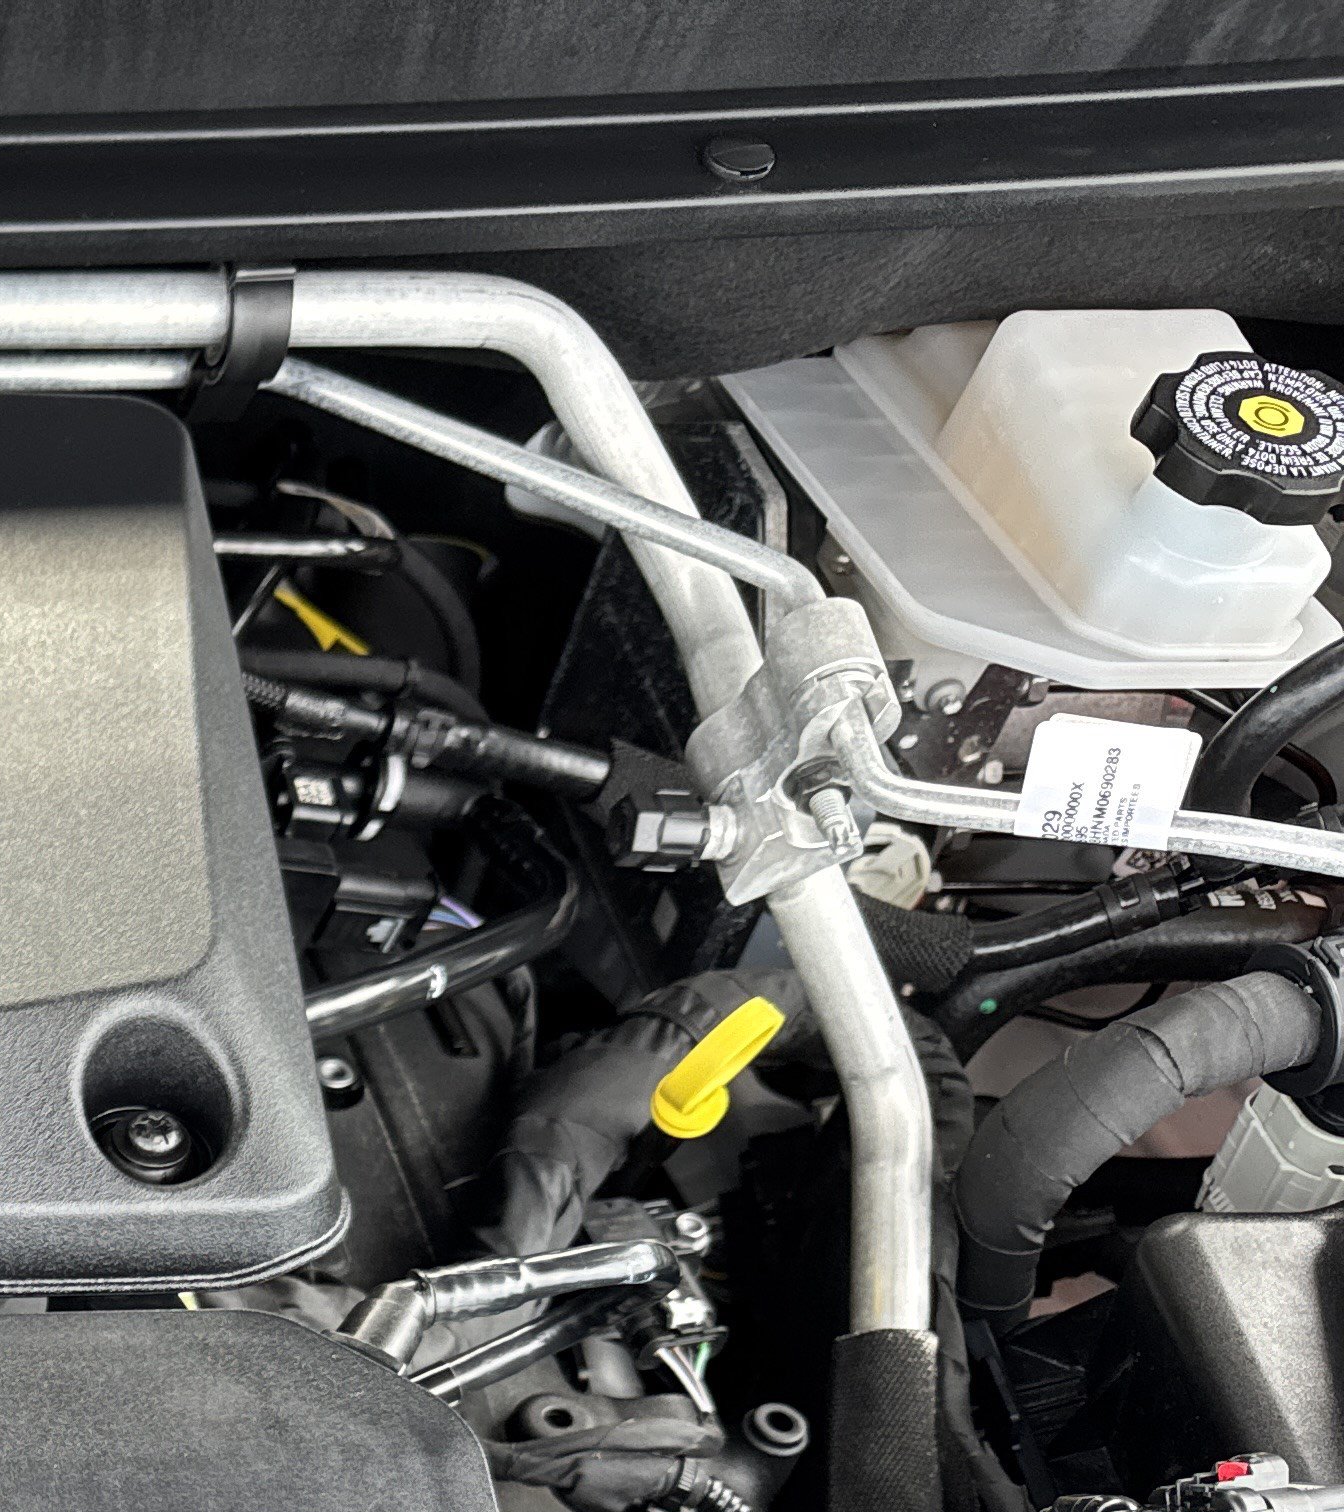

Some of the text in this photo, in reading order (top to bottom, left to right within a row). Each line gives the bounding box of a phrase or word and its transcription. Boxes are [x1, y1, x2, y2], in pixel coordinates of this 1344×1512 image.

[1243, 370, 1263, 379] CAP
[1217, 418, 1251, 443] FILLER
[1216, 433, 1245, 452] ONLY
[1280, 455, 1314, 465] FREIN
[1290, 467, 1307, 476] LA
